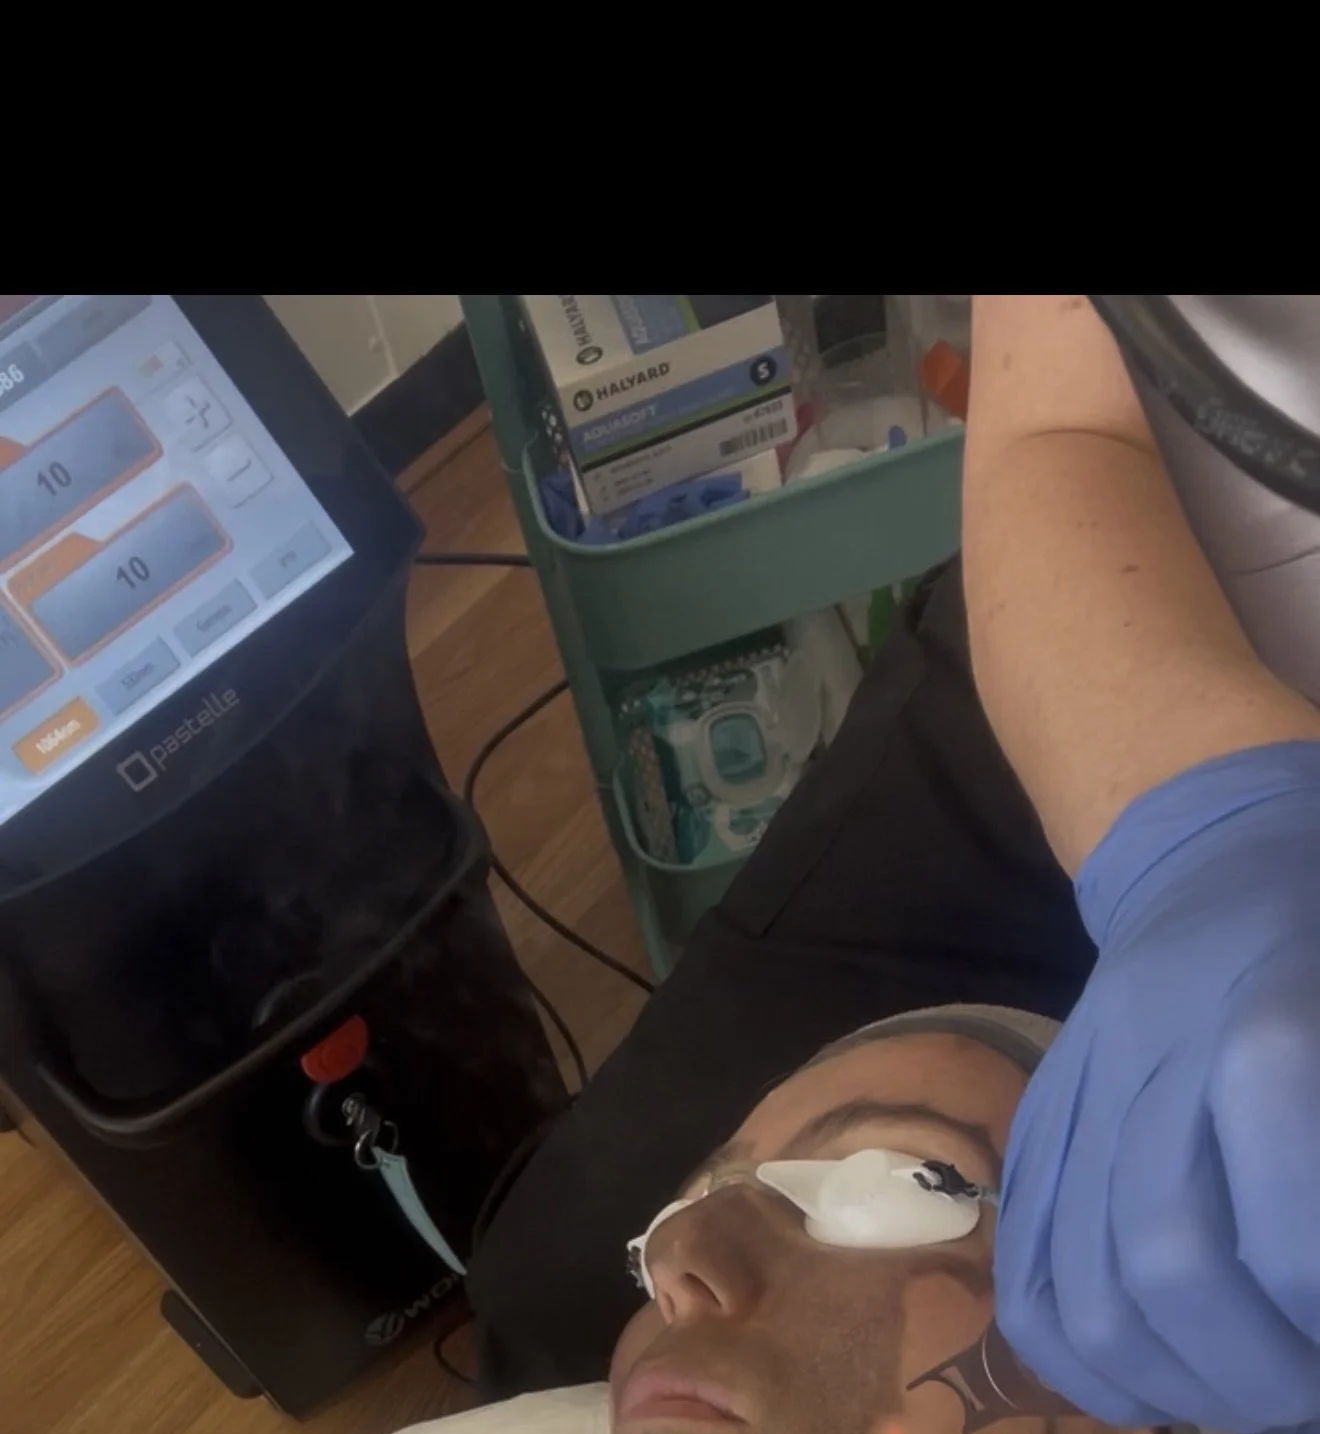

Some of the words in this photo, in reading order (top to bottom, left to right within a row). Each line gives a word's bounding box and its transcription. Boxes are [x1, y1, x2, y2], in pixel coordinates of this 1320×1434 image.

[560, 295, 593, 347] HALYAR
[596, 362, 670, 401] HALYARD
[756, 361, 770, 379] S
[584, 406, 657, 443] AQUASOFT
[36, 461, 72, 496] 10
[117, 556, 150, 589] 10
[149, 688, 240, 773] pastelle
[403, 1273, 459, 1318] WO
